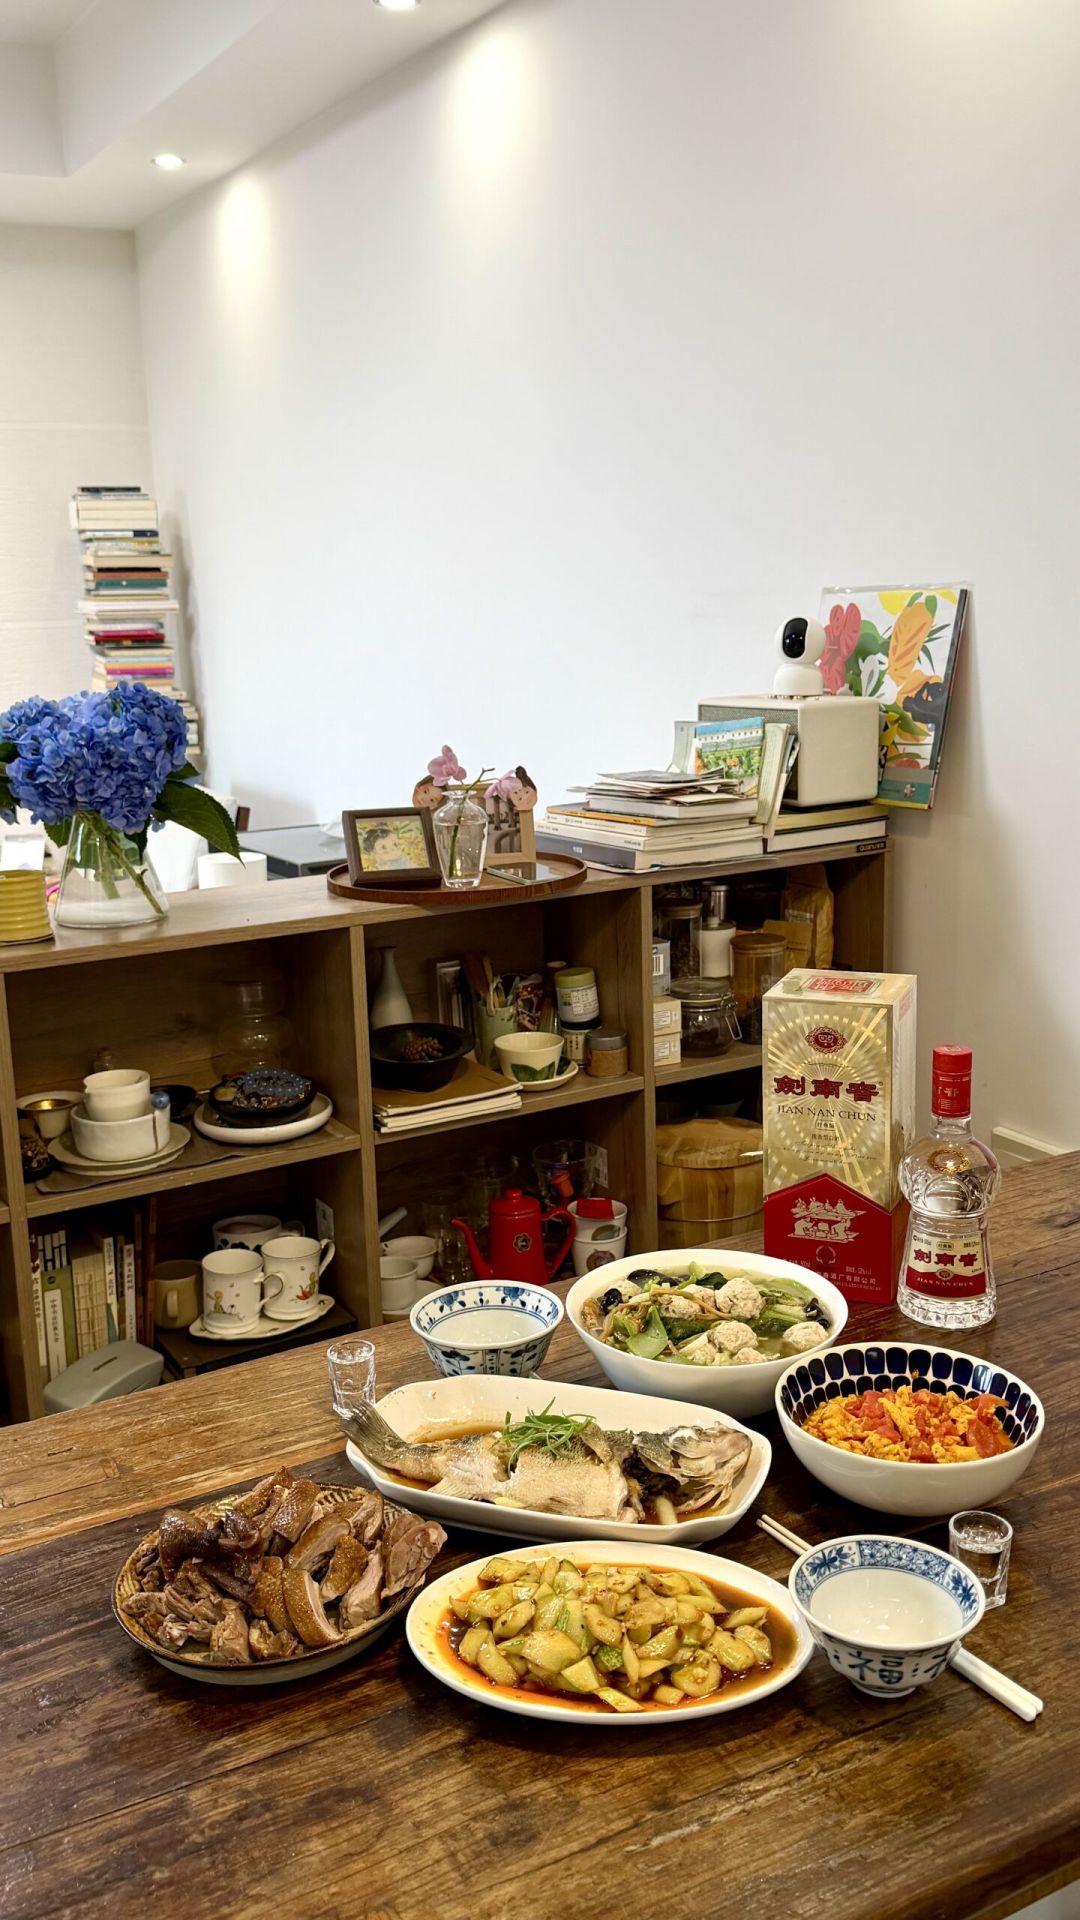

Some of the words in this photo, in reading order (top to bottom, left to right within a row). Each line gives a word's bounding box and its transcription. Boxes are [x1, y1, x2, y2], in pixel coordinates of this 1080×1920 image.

[777, 1105, 804, 1116] JIAN
[807, 1108, 835, 1118] NAN
[838, 1110, 876, 1121] CHUN
[917, 1277, 933, 1285] JIAN
